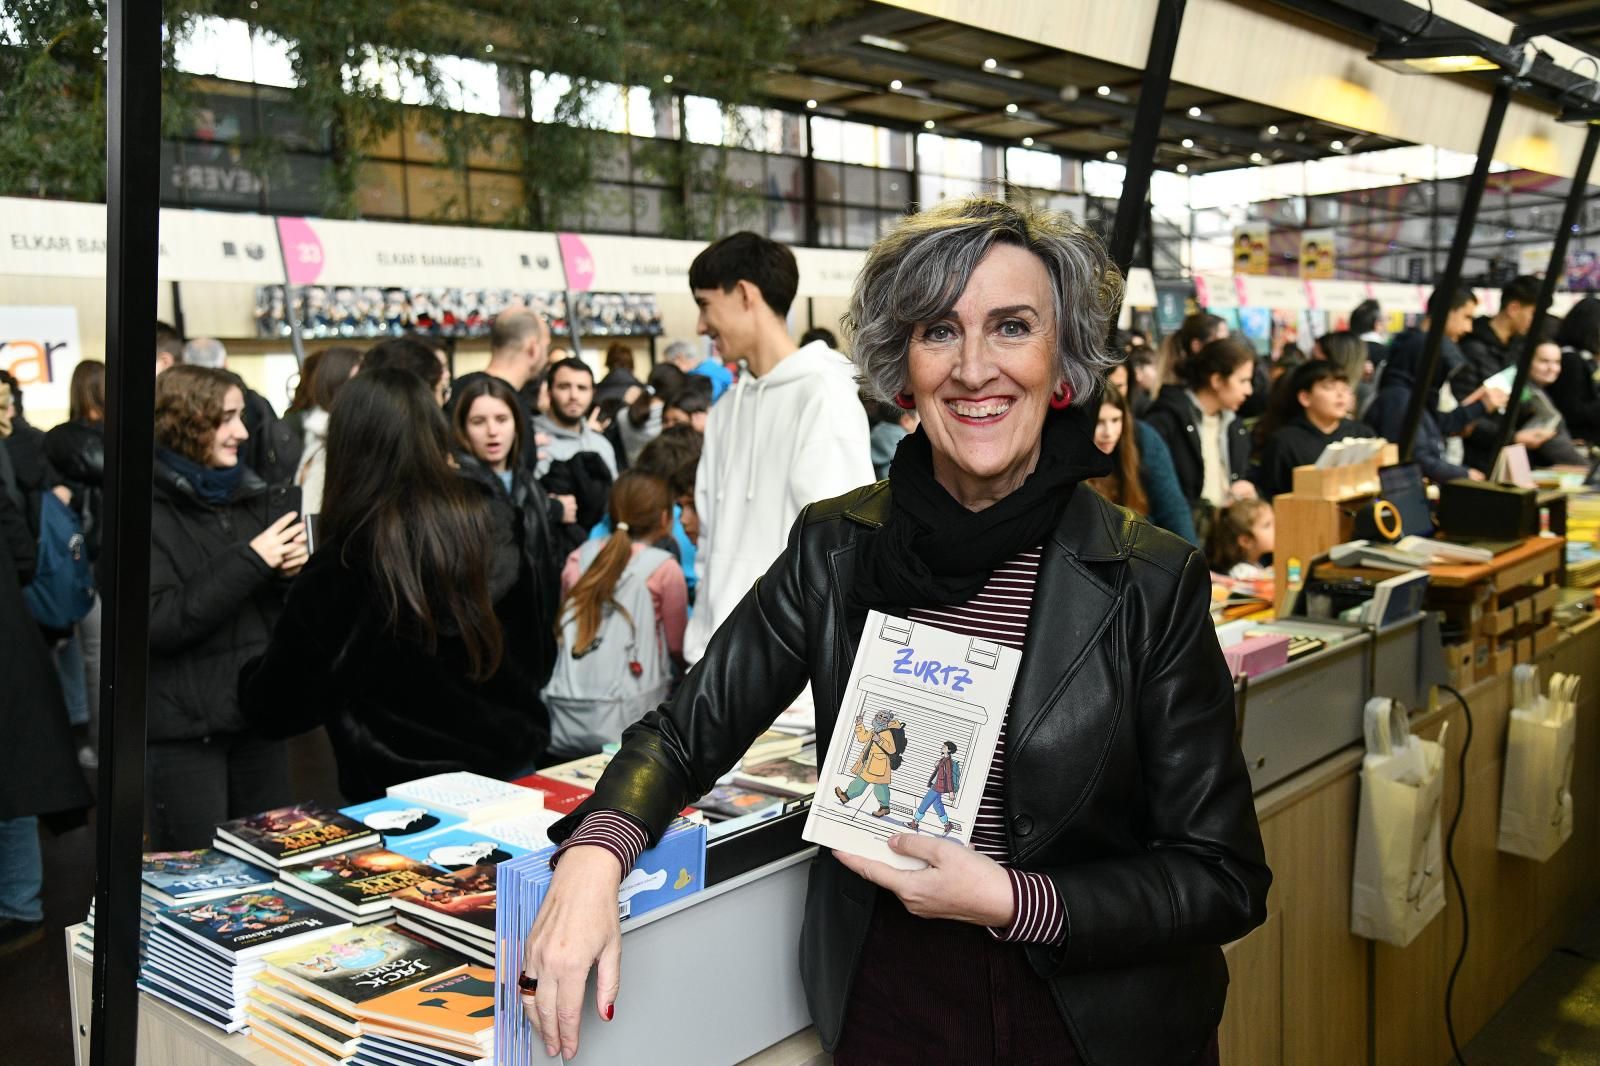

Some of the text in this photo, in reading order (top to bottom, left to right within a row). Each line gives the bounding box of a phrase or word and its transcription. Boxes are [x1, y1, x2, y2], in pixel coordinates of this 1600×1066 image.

[10, 233, 71, 251] ELKAR
[376, 251, 416, 267] ELKAR
[893, 648, 973, 692] ZURTZ
[355, 958, 431, 989] JACK
